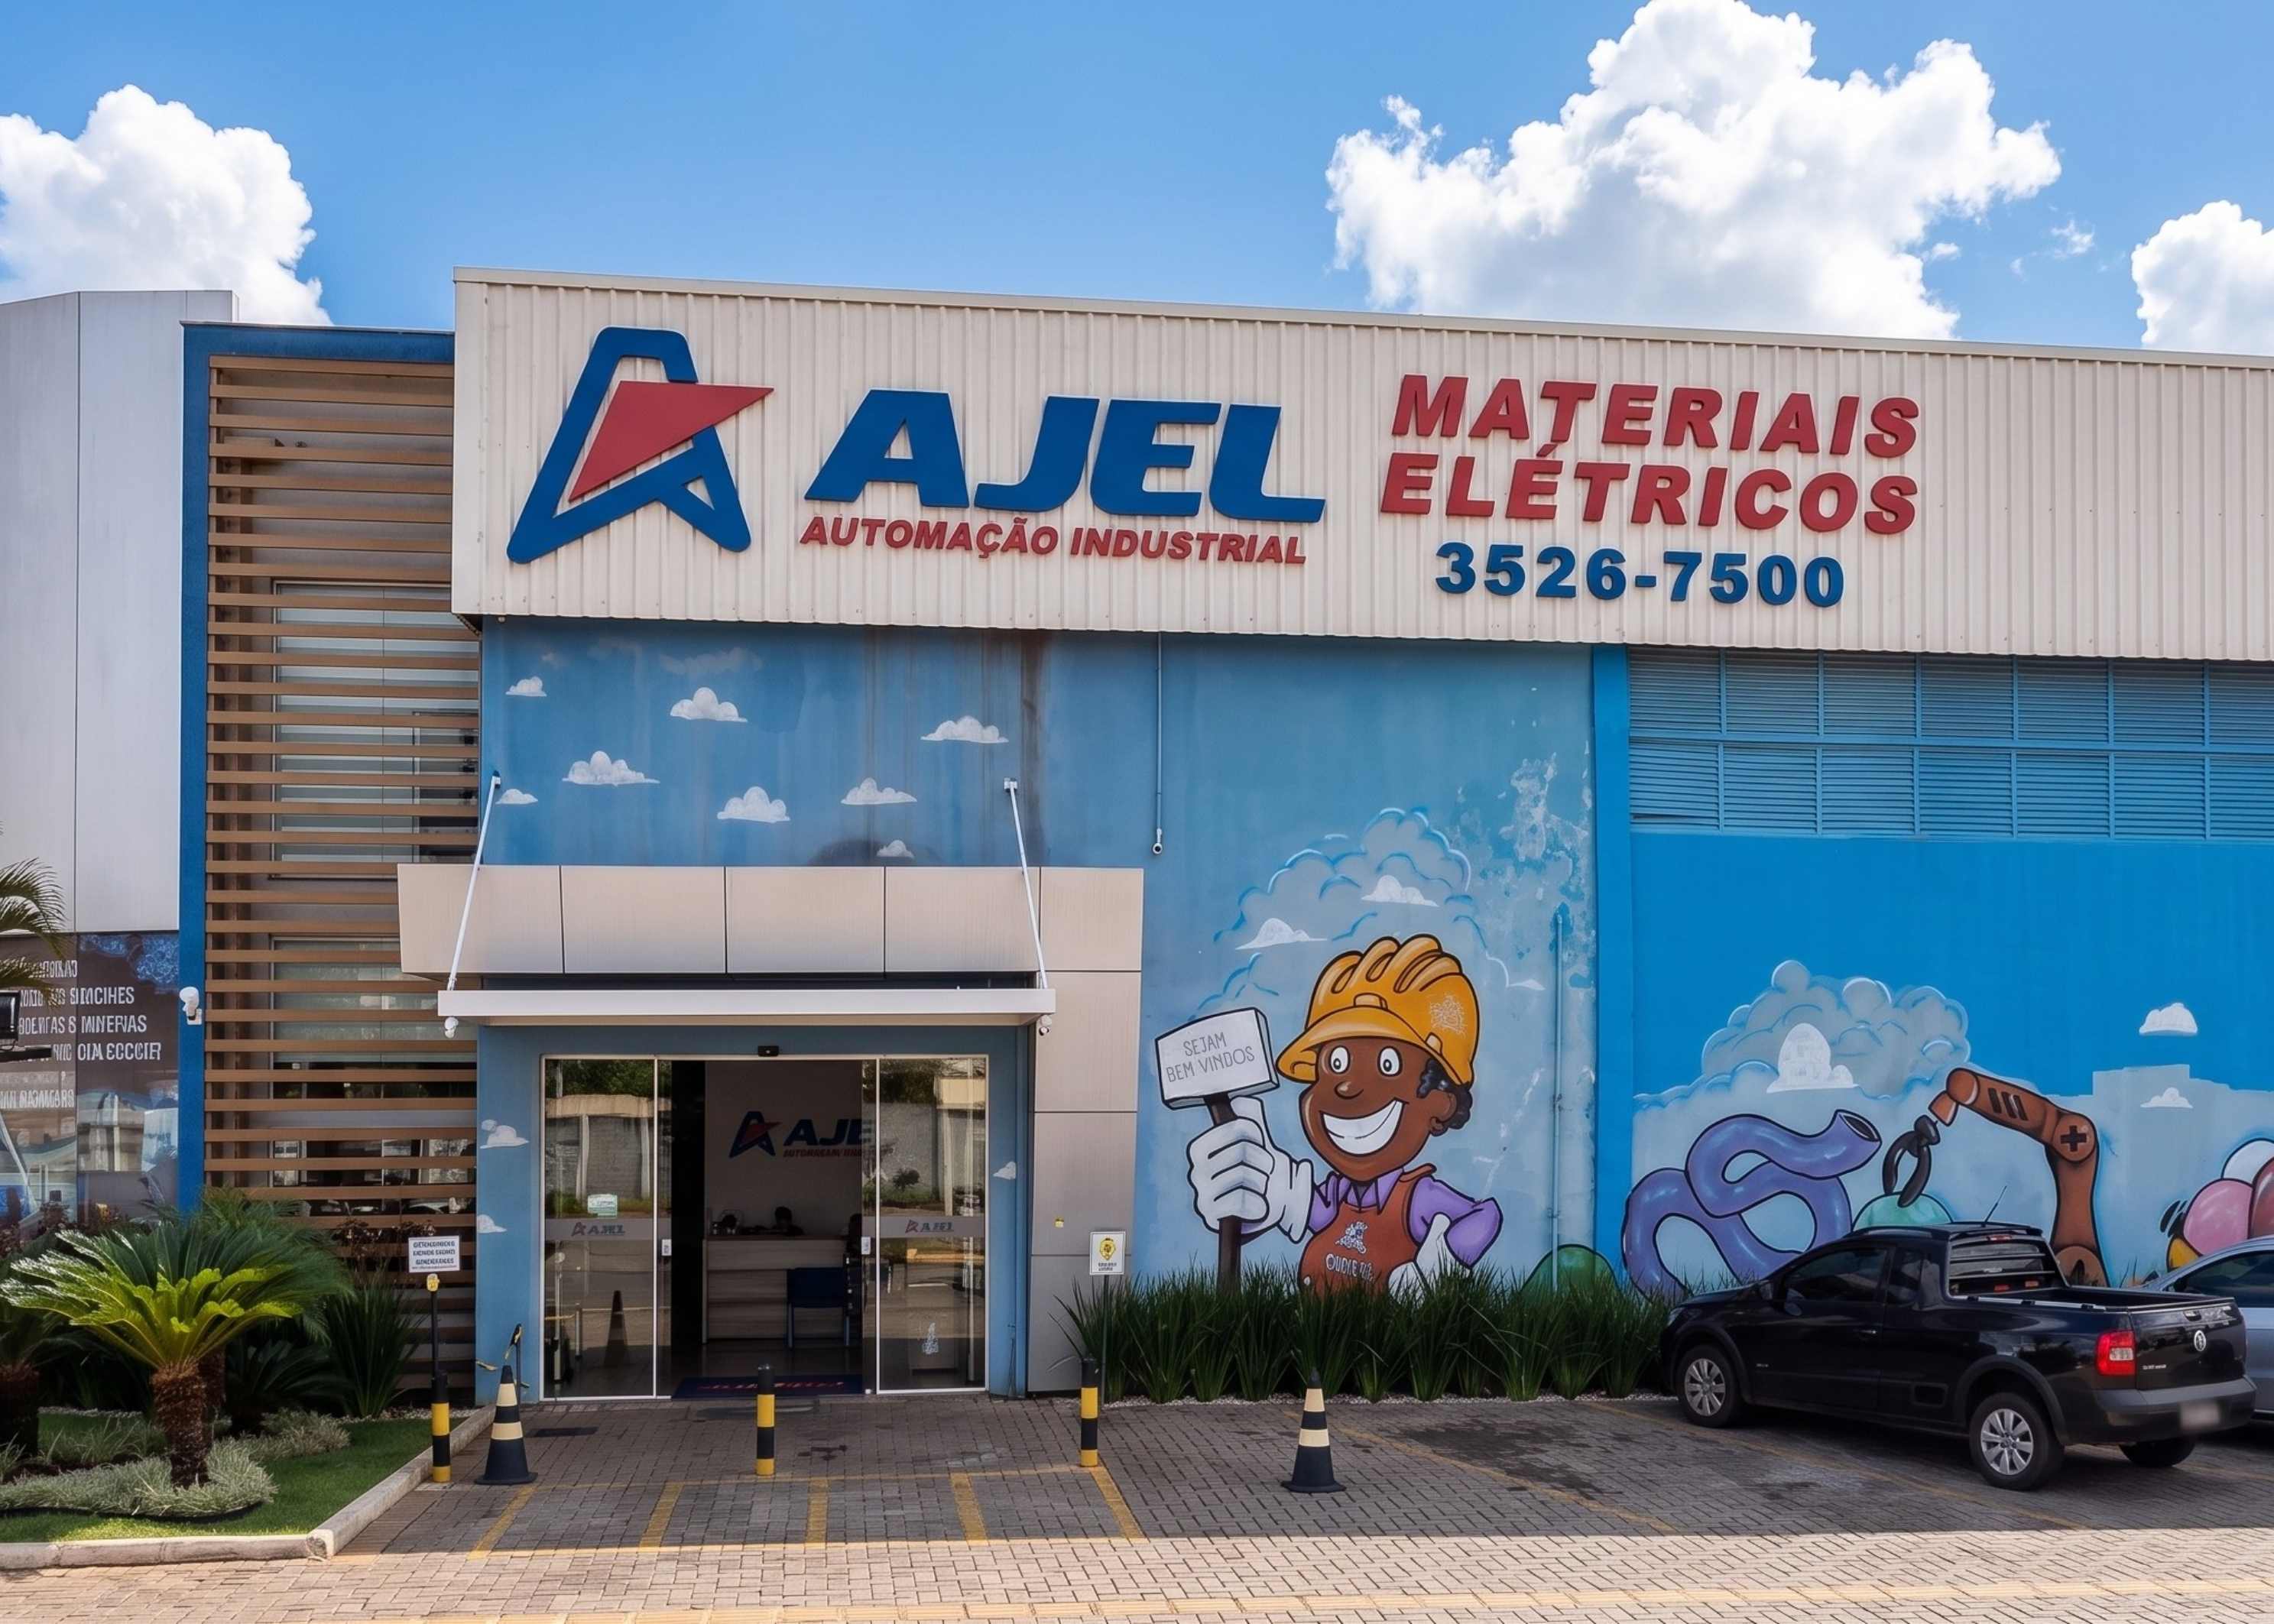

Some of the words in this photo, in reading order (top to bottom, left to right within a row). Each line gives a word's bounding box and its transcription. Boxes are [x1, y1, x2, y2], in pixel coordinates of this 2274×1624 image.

[1391, 374, 1919, 459] MATERIAIS
[805, 388, 1326, 524] AJEL
[1380, 444, 1918, 536] ELÉTRICOS
[800, 516, 1059, 559] AUTOMAÇÃO
[1069, 527, 1306, 567] INDUSTRIAL
[1435, 541, 1844, 608] 3526-7500
[1166, 1061, 1195, 1082] BEM
[1198, 1045, 1254, 1073] VINDOS
[1183, 1032, 1227, 1056] SEJAM
